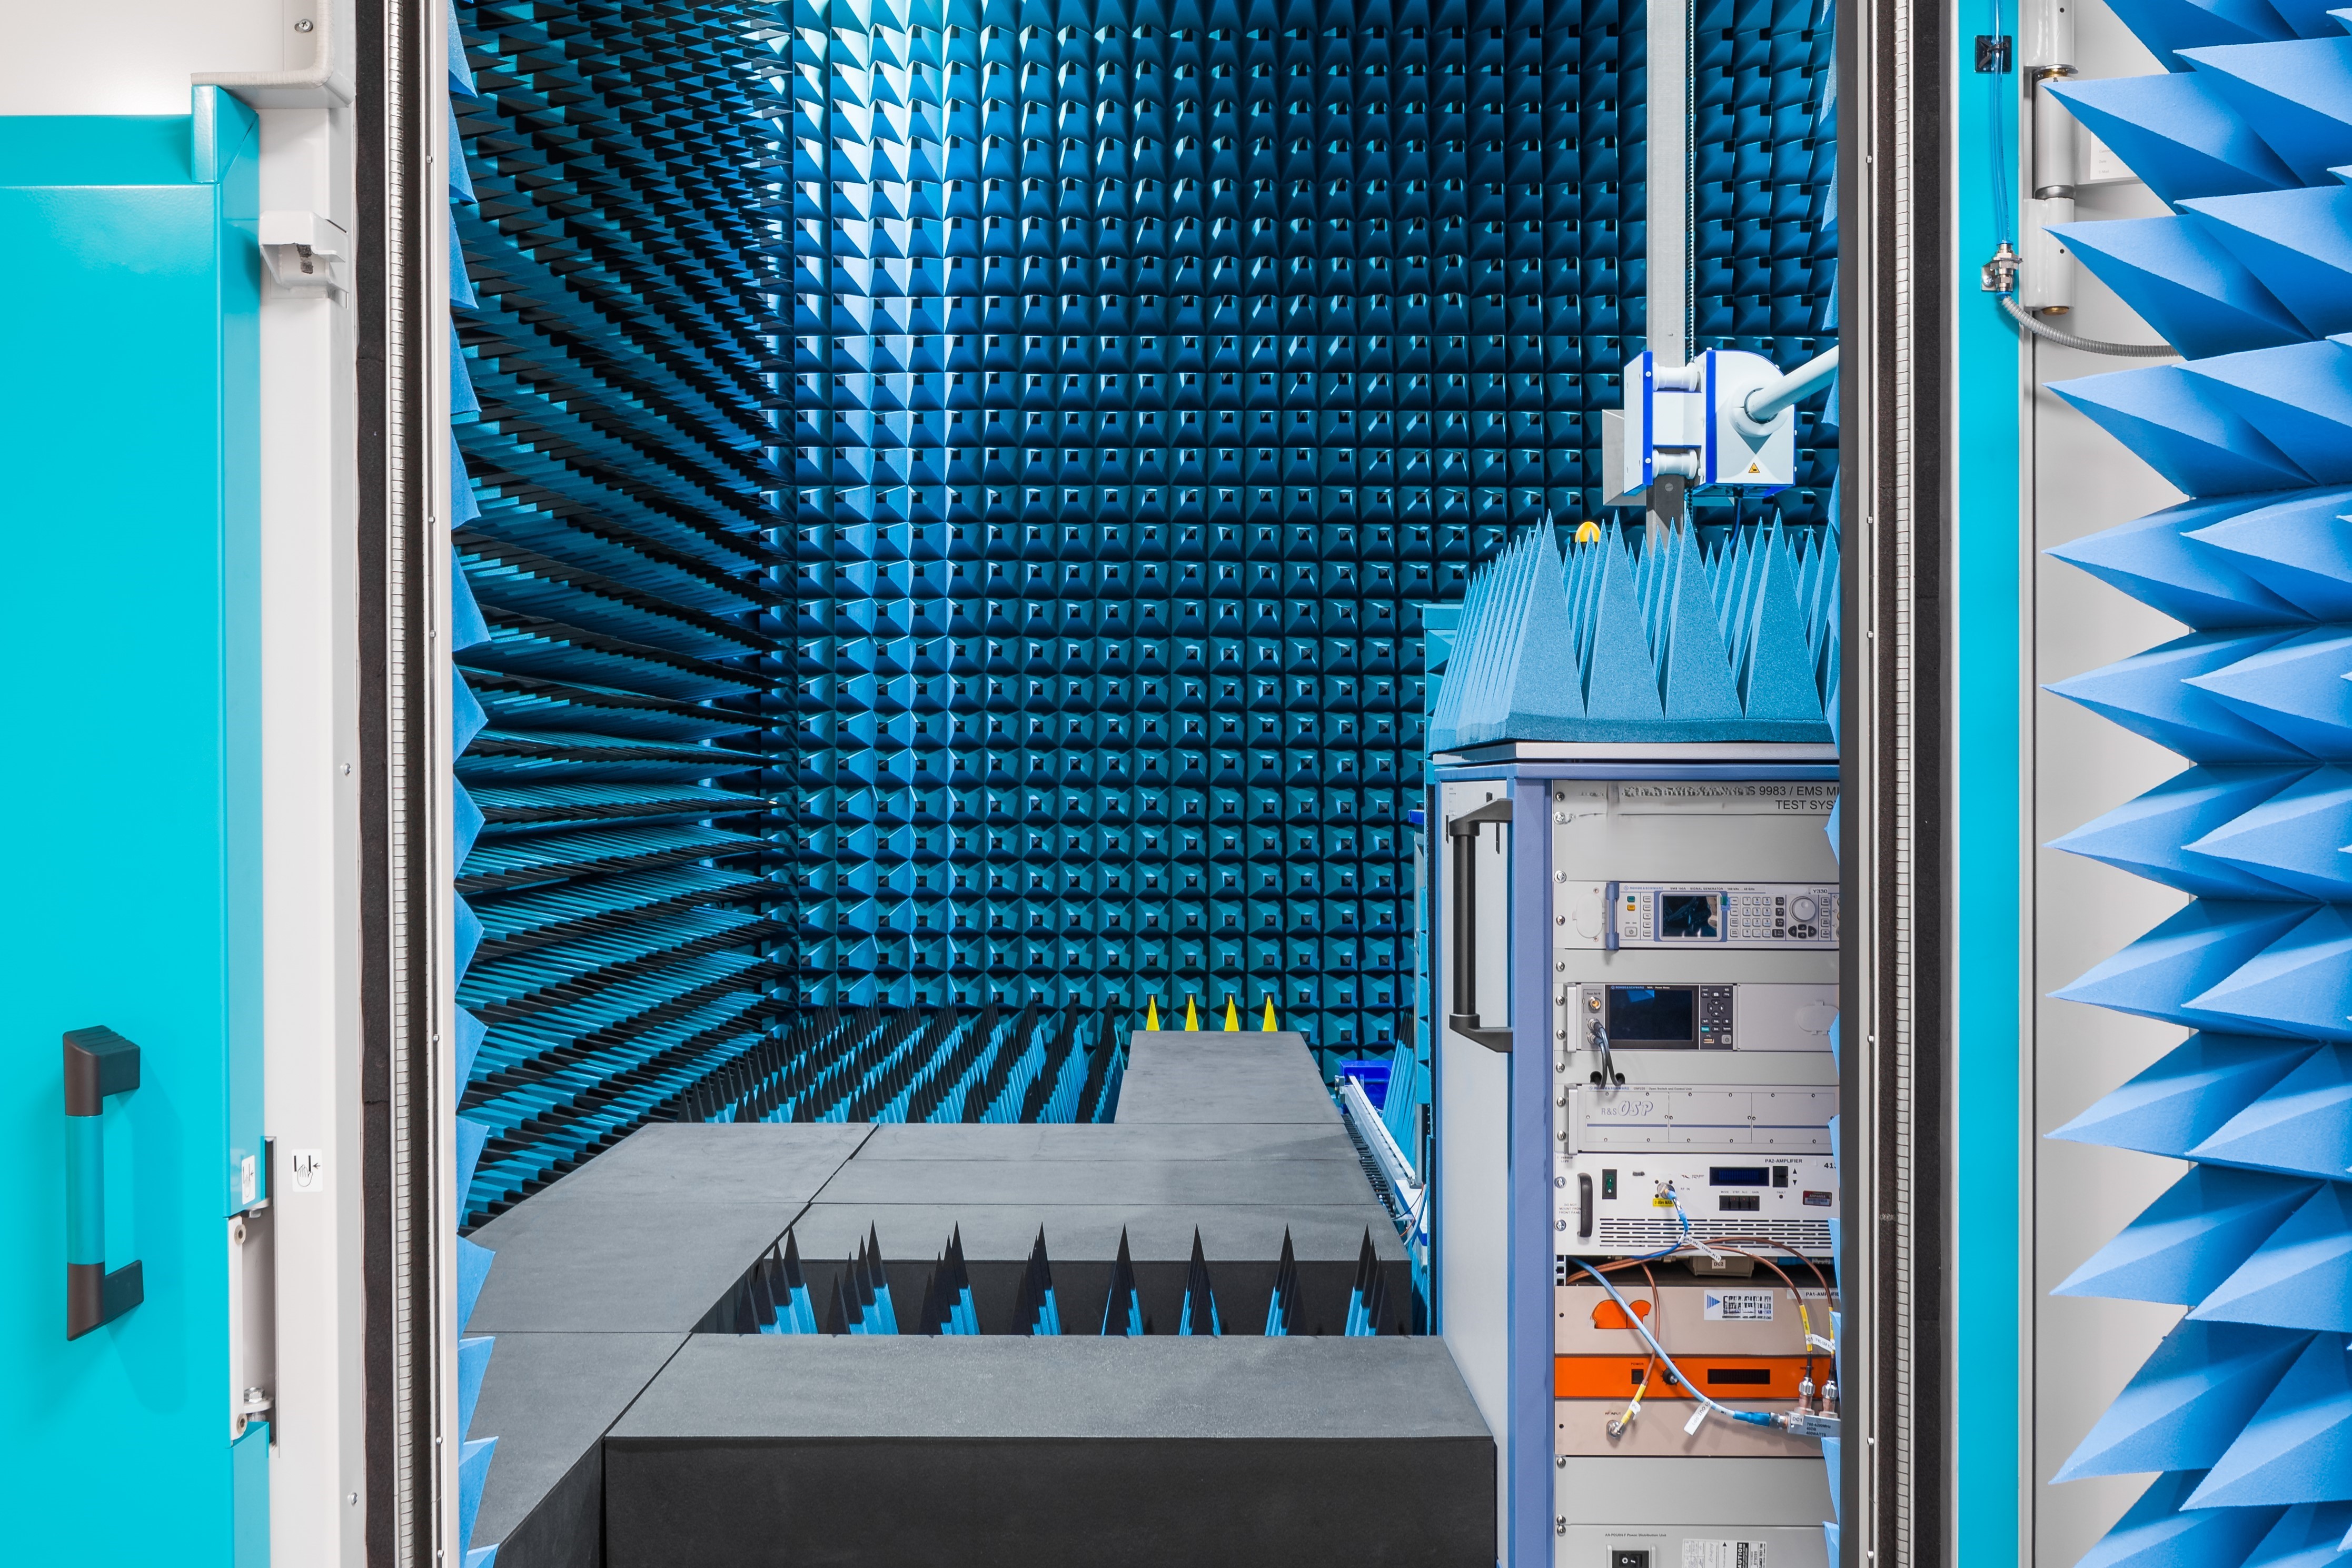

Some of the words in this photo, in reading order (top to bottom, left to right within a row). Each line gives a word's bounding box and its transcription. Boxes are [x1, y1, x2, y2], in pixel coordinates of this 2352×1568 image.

[1759, 786, 1786, 796] 9983
[1789, 786, 1793, 796] /
[1797, 786, 1822, 796] EMS
[1775, 800, 1807, 809] TEST
[1810, 800, 1836, 810] SYS
[1618, 1100, 1653, 1116] OSP
